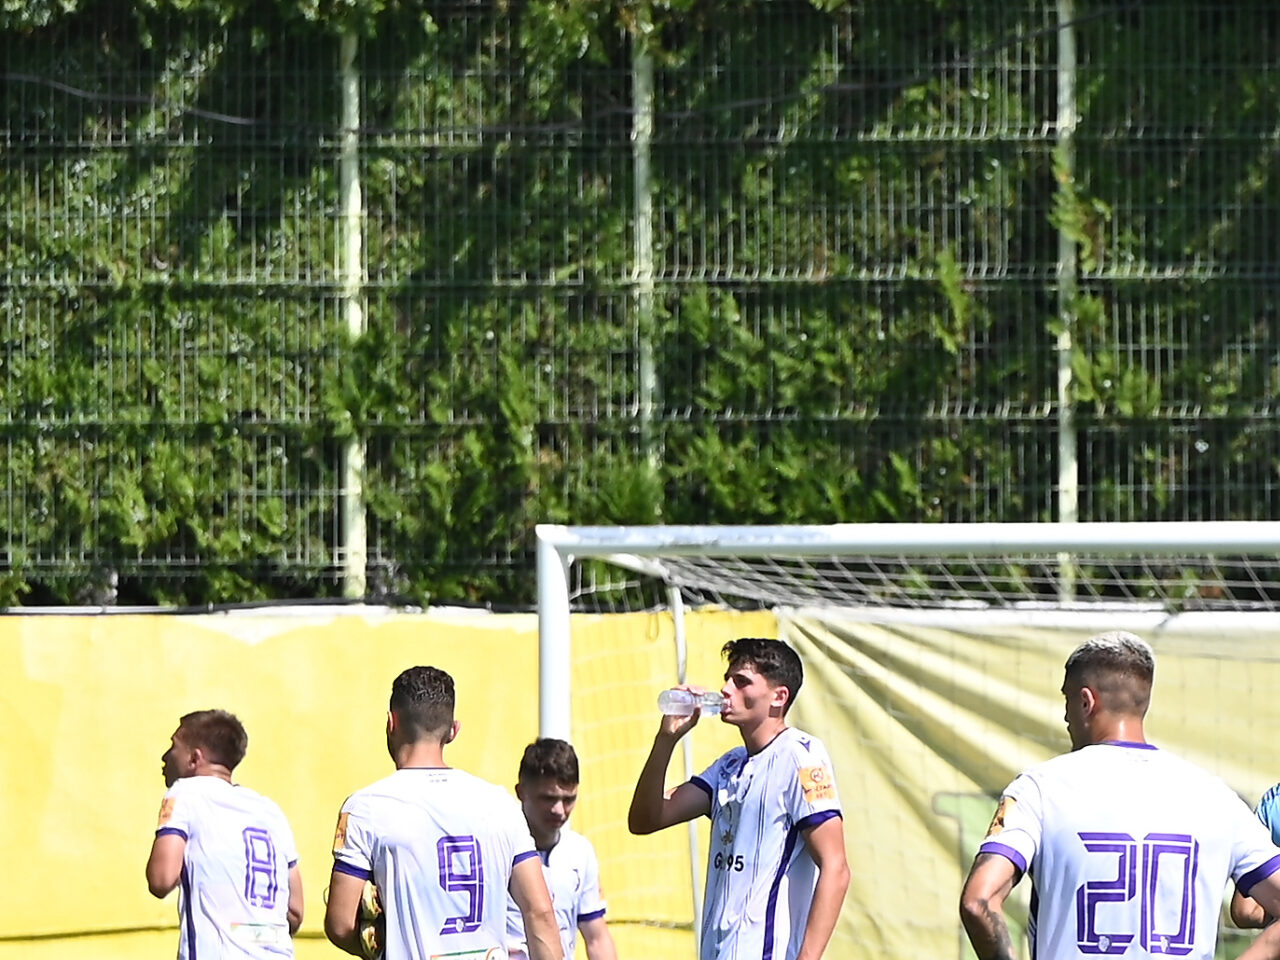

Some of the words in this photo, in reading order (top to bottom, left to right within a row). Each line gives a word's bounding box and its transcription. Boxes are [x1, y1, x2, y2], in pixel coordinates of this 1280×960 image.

[243, 826, 278, 910] 8
[437, 835, 484, 936] 9
[1077, 832, 1199, 955] 20
